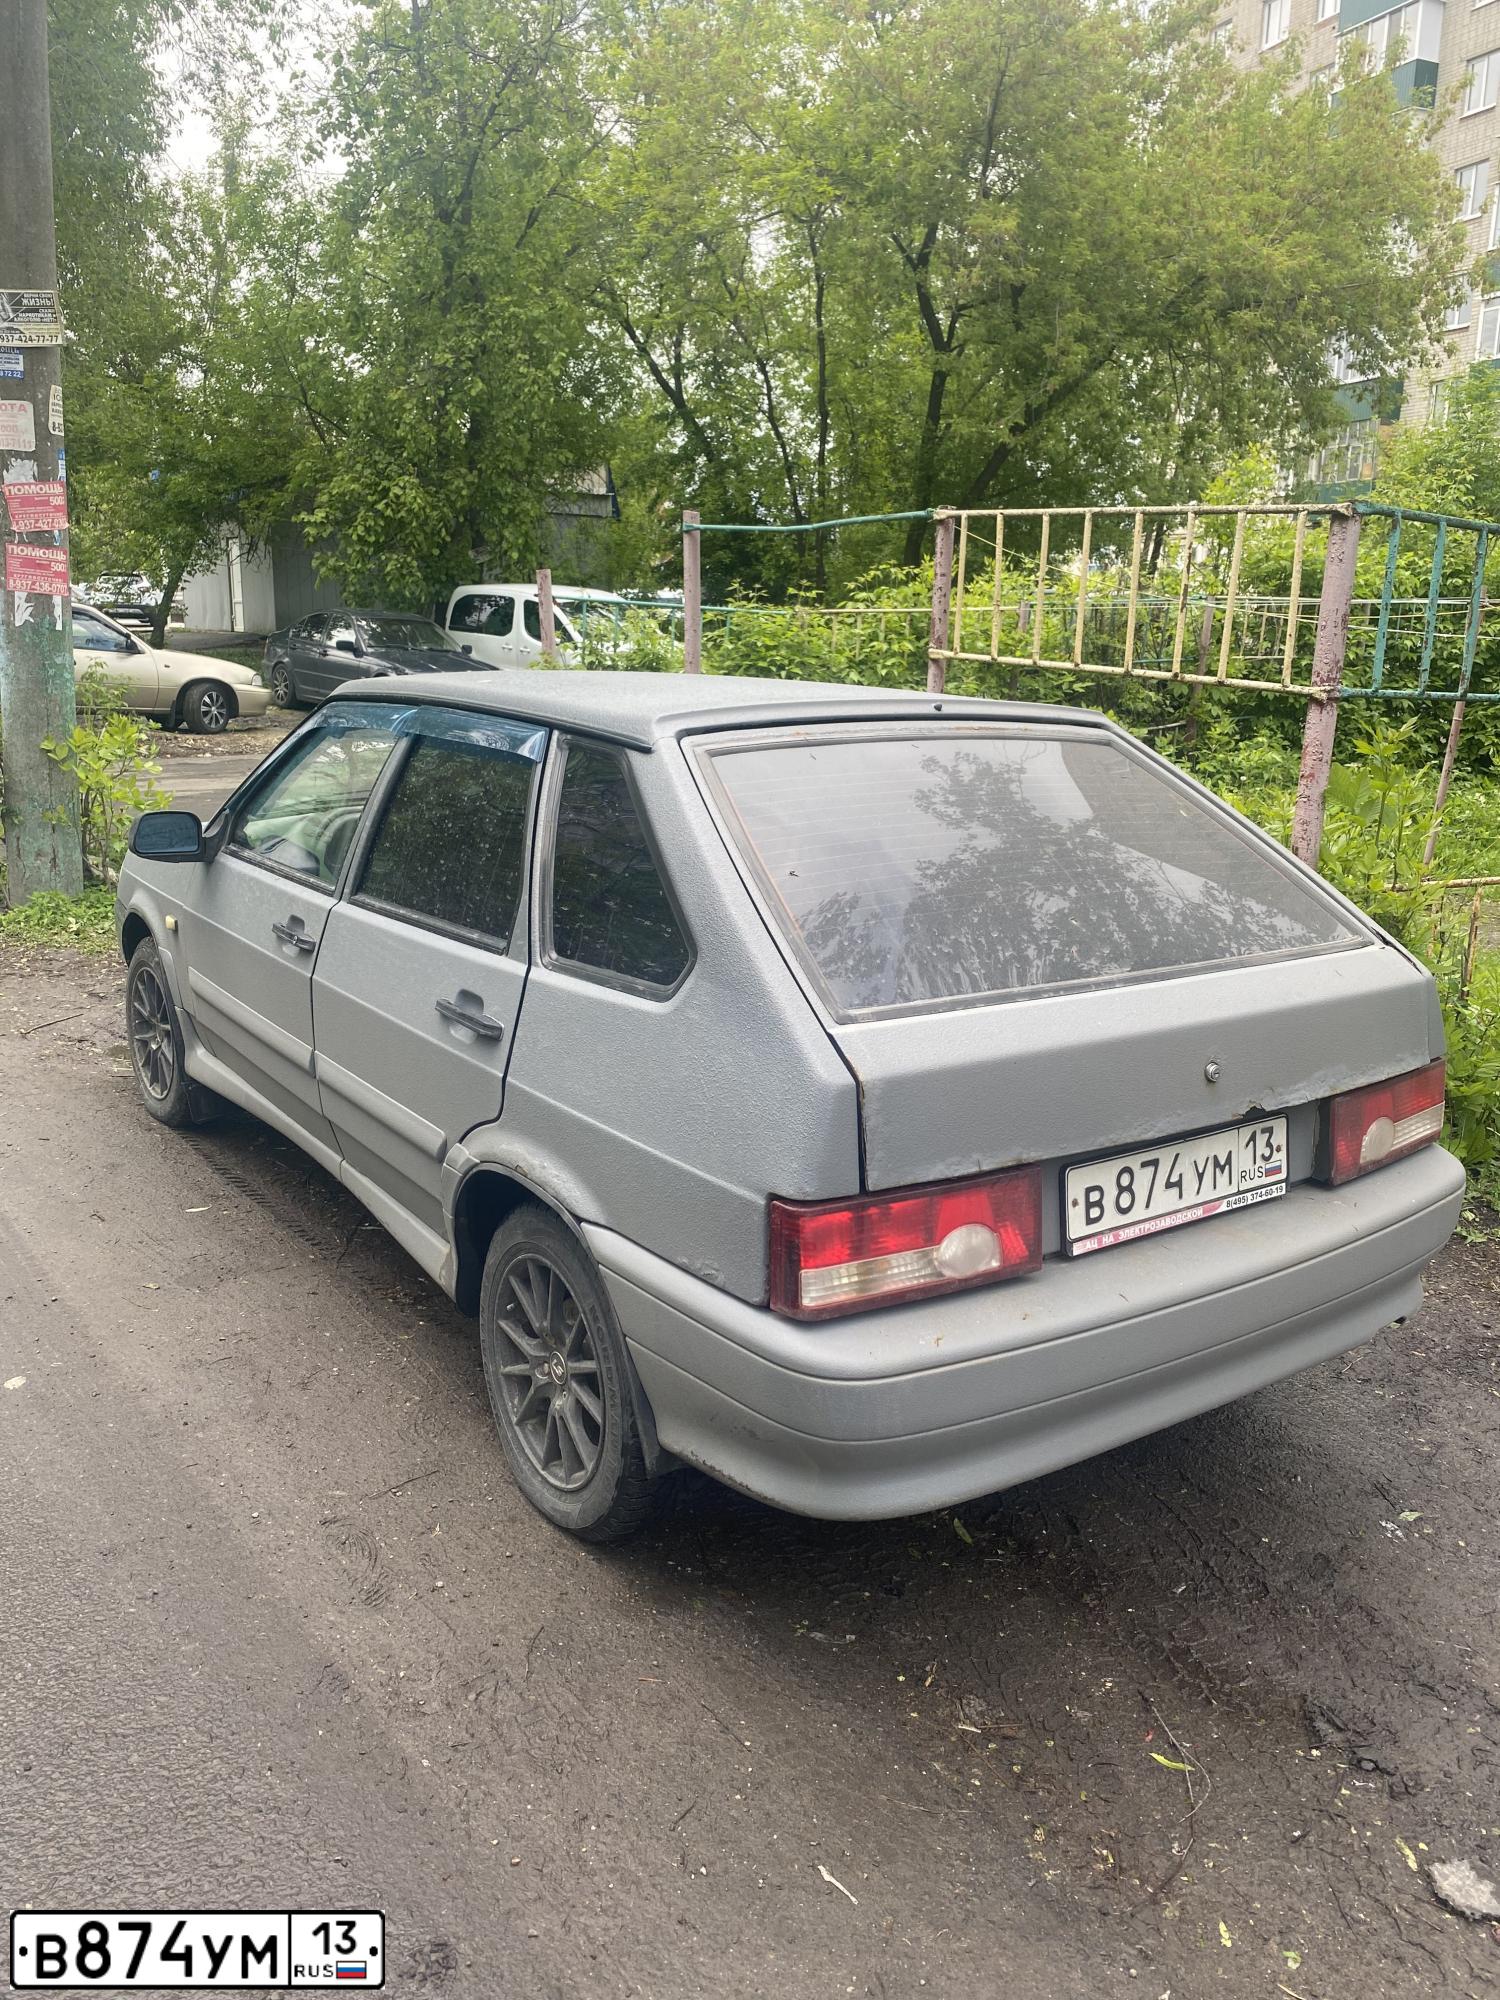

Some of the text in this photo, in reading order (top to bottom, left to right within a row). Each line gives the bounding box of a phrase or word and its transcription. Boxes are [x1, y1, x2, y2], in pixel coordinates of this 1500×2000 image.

[21, 297, 54, 306] ЖИЗНЬ!
[5, 483, 64, 496] ПОМОЩЬ
[8, 544, 66, 562] ПОМОЩЬ
[1085, 1125, 1274, 1225] В874УМ 13
[1240, 1165, 1264, 1183] RUS
[1102, 1233, 1115, 1246] НА
[1118, 1207, 1204, 1240] ЭЛЕКТРОЗАВОДСКОЙ
[1226, 1194, 1249, 1209] 8(495)
[1250, 1185, 1284, 1202] 374-60-19
